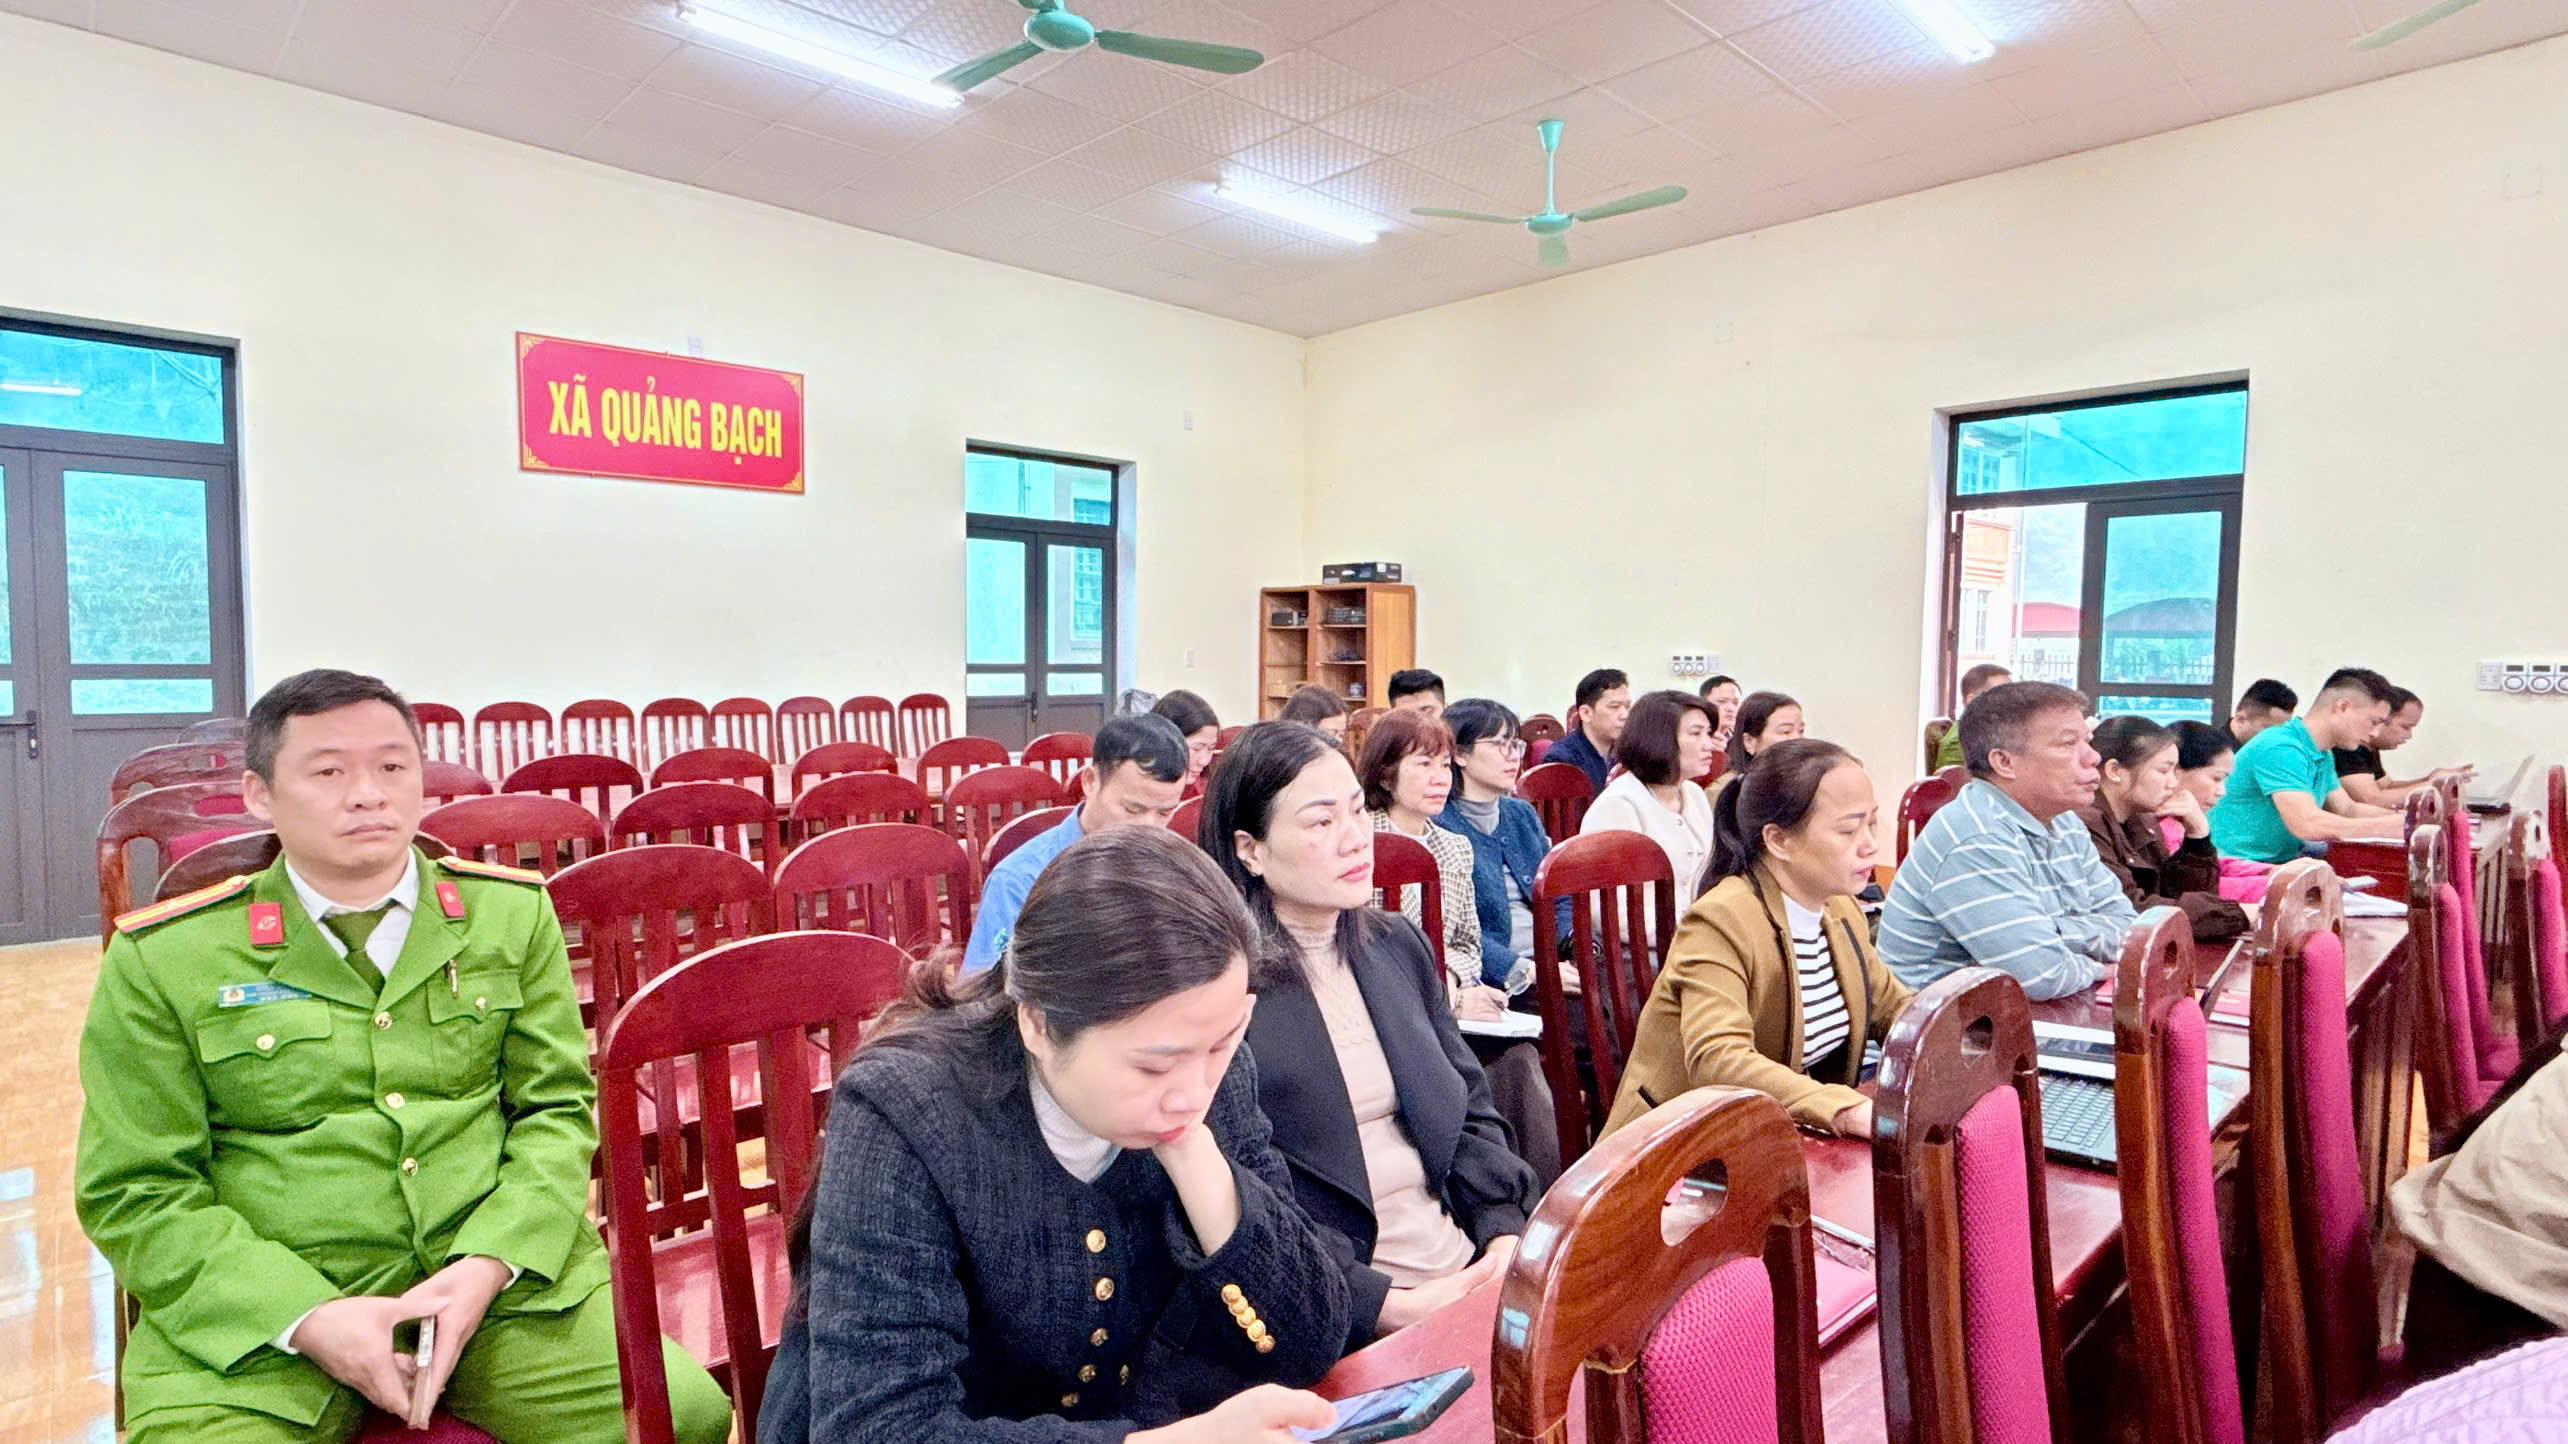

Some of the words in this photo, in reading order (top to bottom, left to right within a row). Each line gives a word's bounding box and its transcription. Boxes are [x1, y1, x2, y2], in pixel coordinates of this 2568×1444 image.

[548, 374, 592, 438] XÃ
[601, 376, 702, 449] QUẢNG
[710, 402, 782, 464] BẠCH
